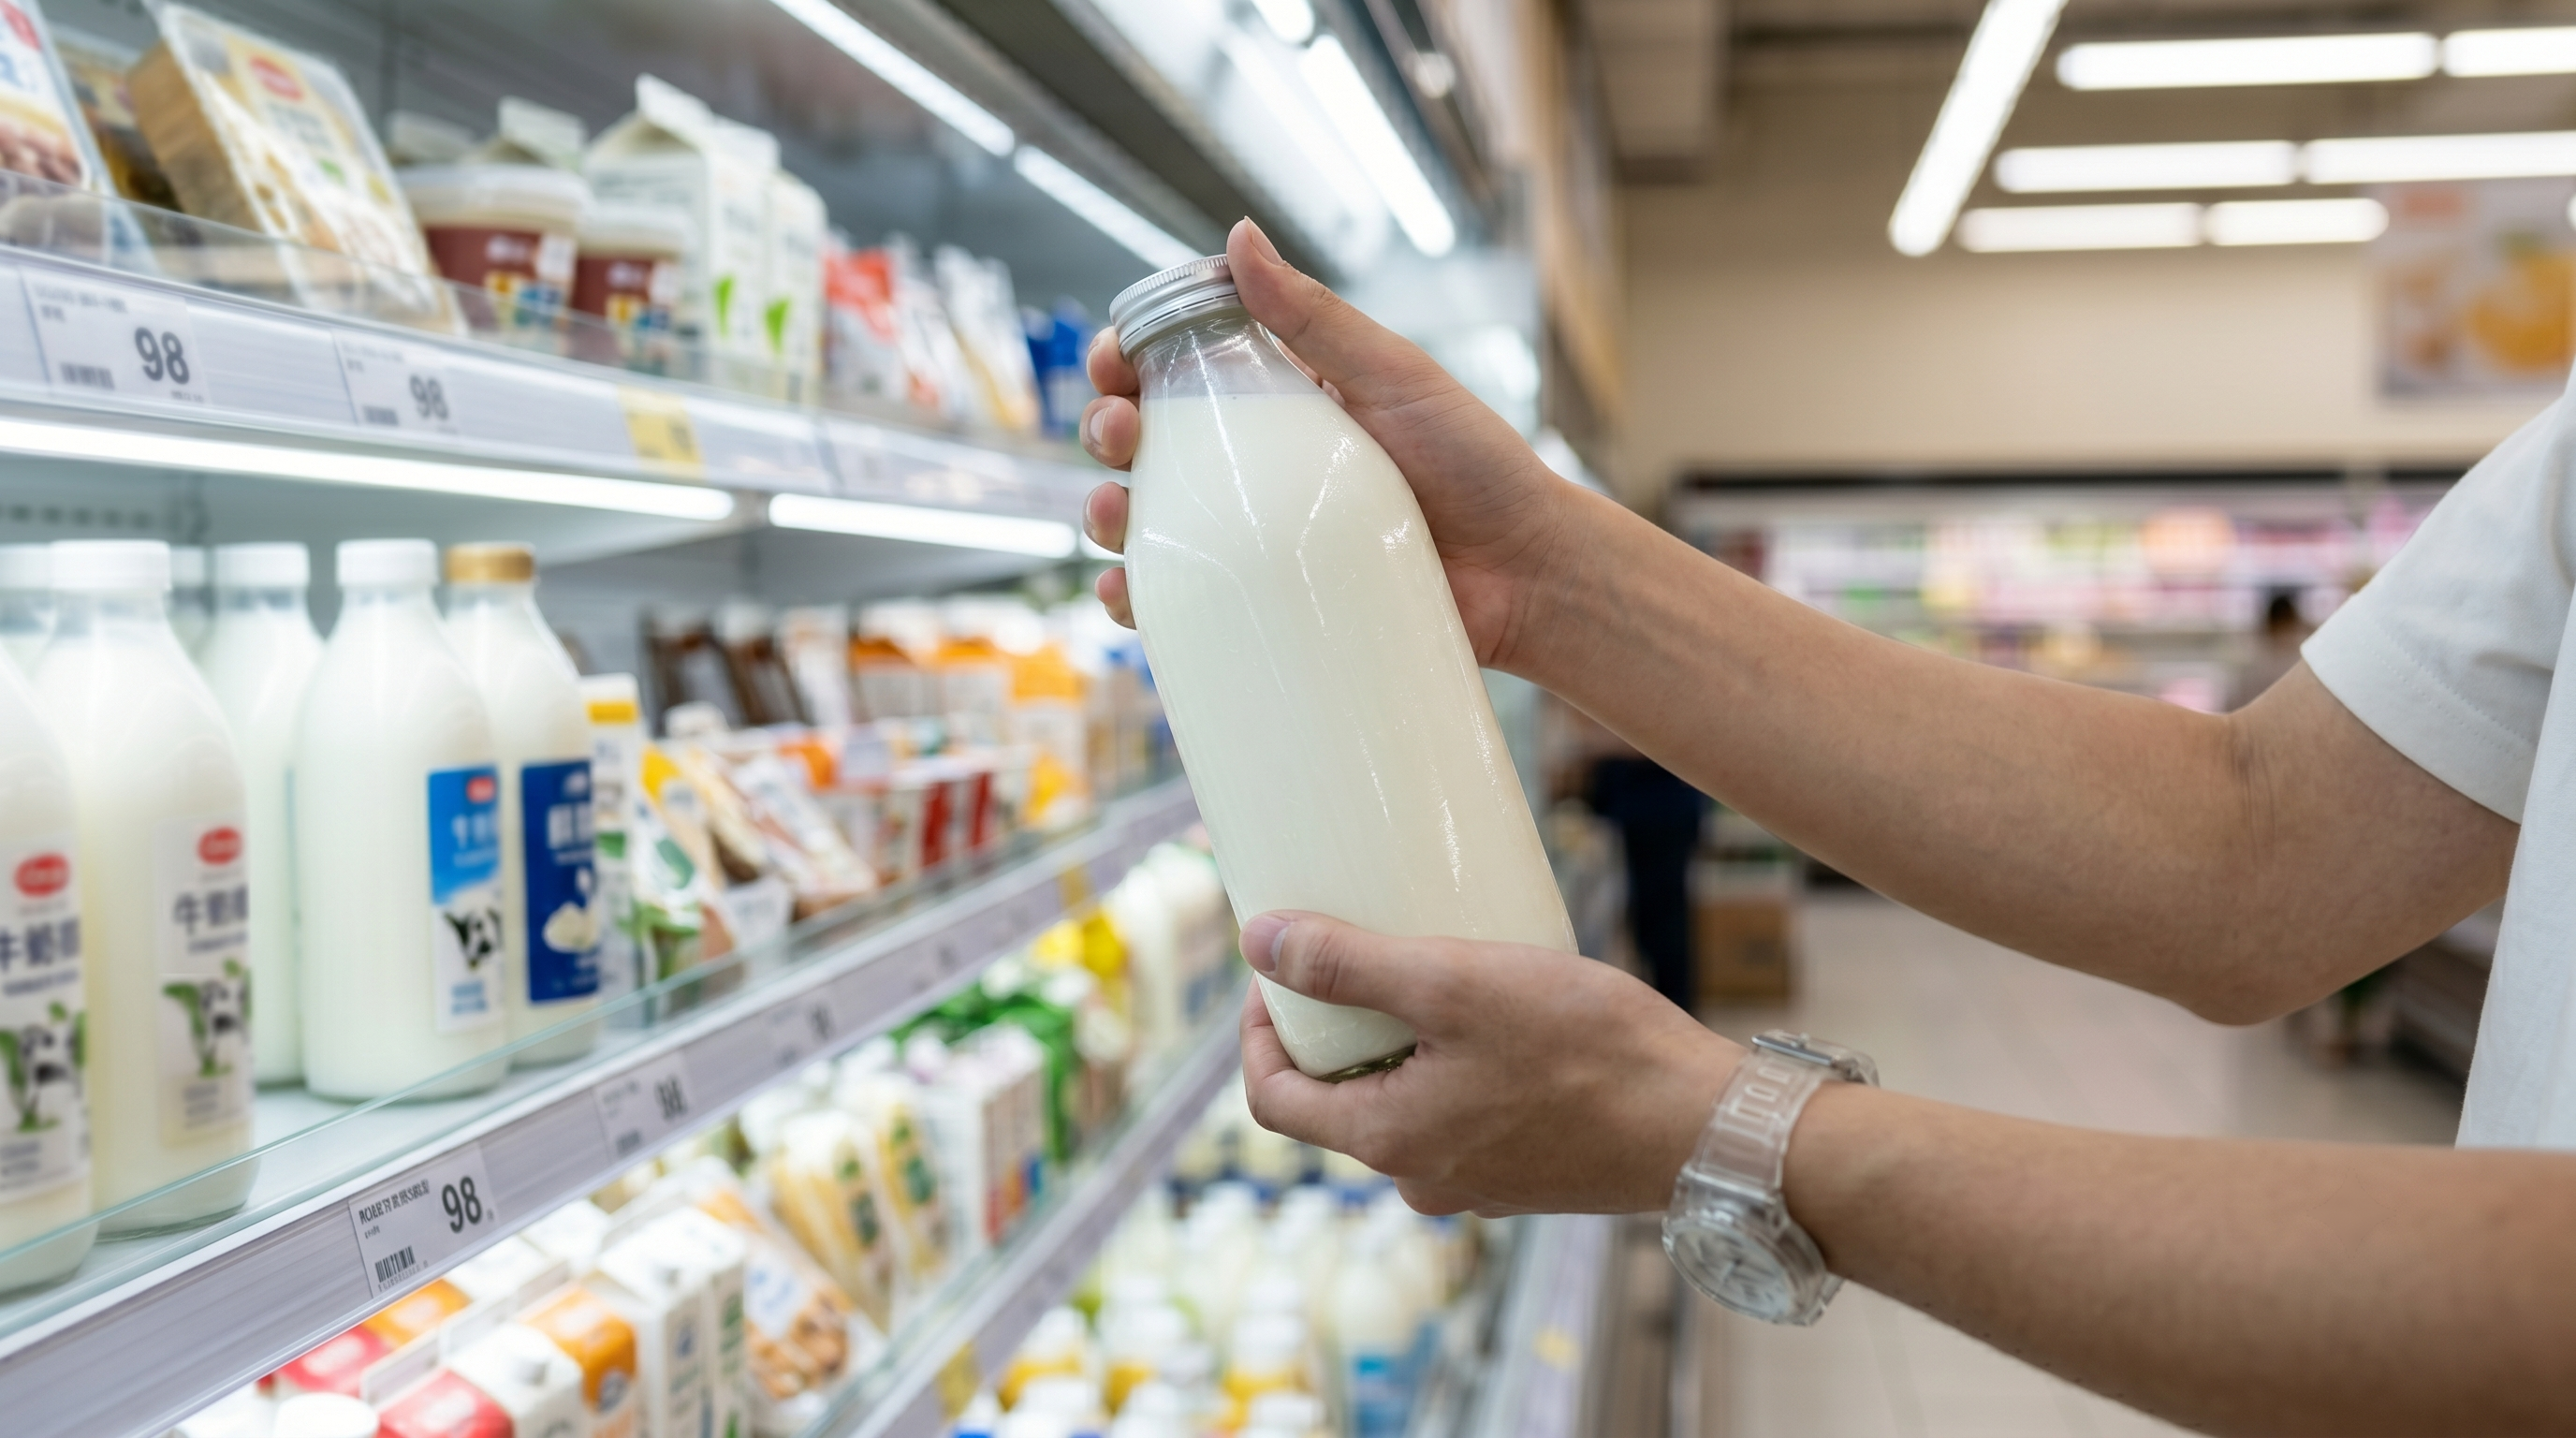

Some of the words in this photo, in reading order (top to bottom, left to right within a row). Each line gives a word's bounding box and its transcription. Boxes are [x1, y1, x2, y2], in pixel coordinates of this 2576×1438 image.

[135, 327, 190, 385] 98
[408, 374, 449, 421] 98
[442, 1175, 483, 1234] 98
